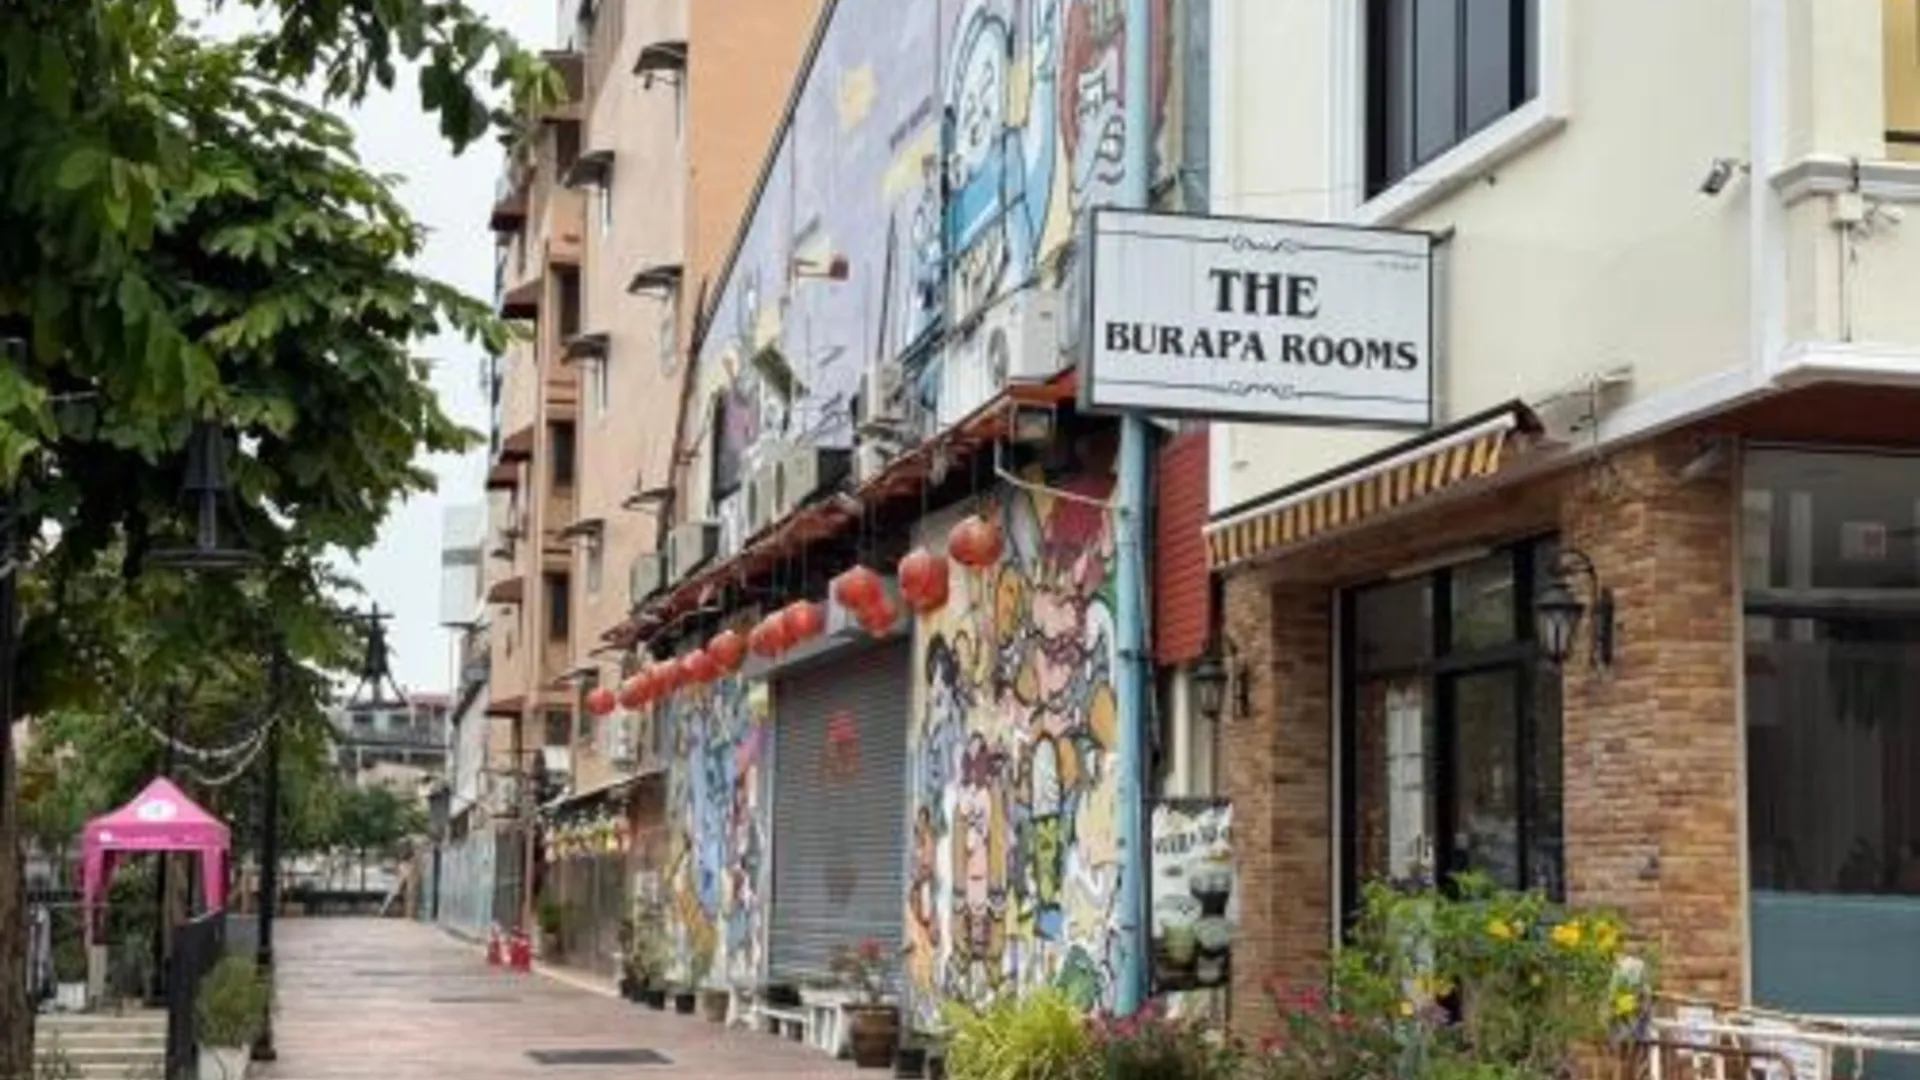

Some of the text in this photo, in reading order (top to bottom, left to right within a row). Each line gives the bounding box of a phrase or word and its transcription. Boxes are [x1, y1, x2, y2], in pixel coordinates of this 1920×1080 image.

[1209, 268, 1319, 319] THE
[1105, 321, 1418, 370] BURAPA ROOMS
